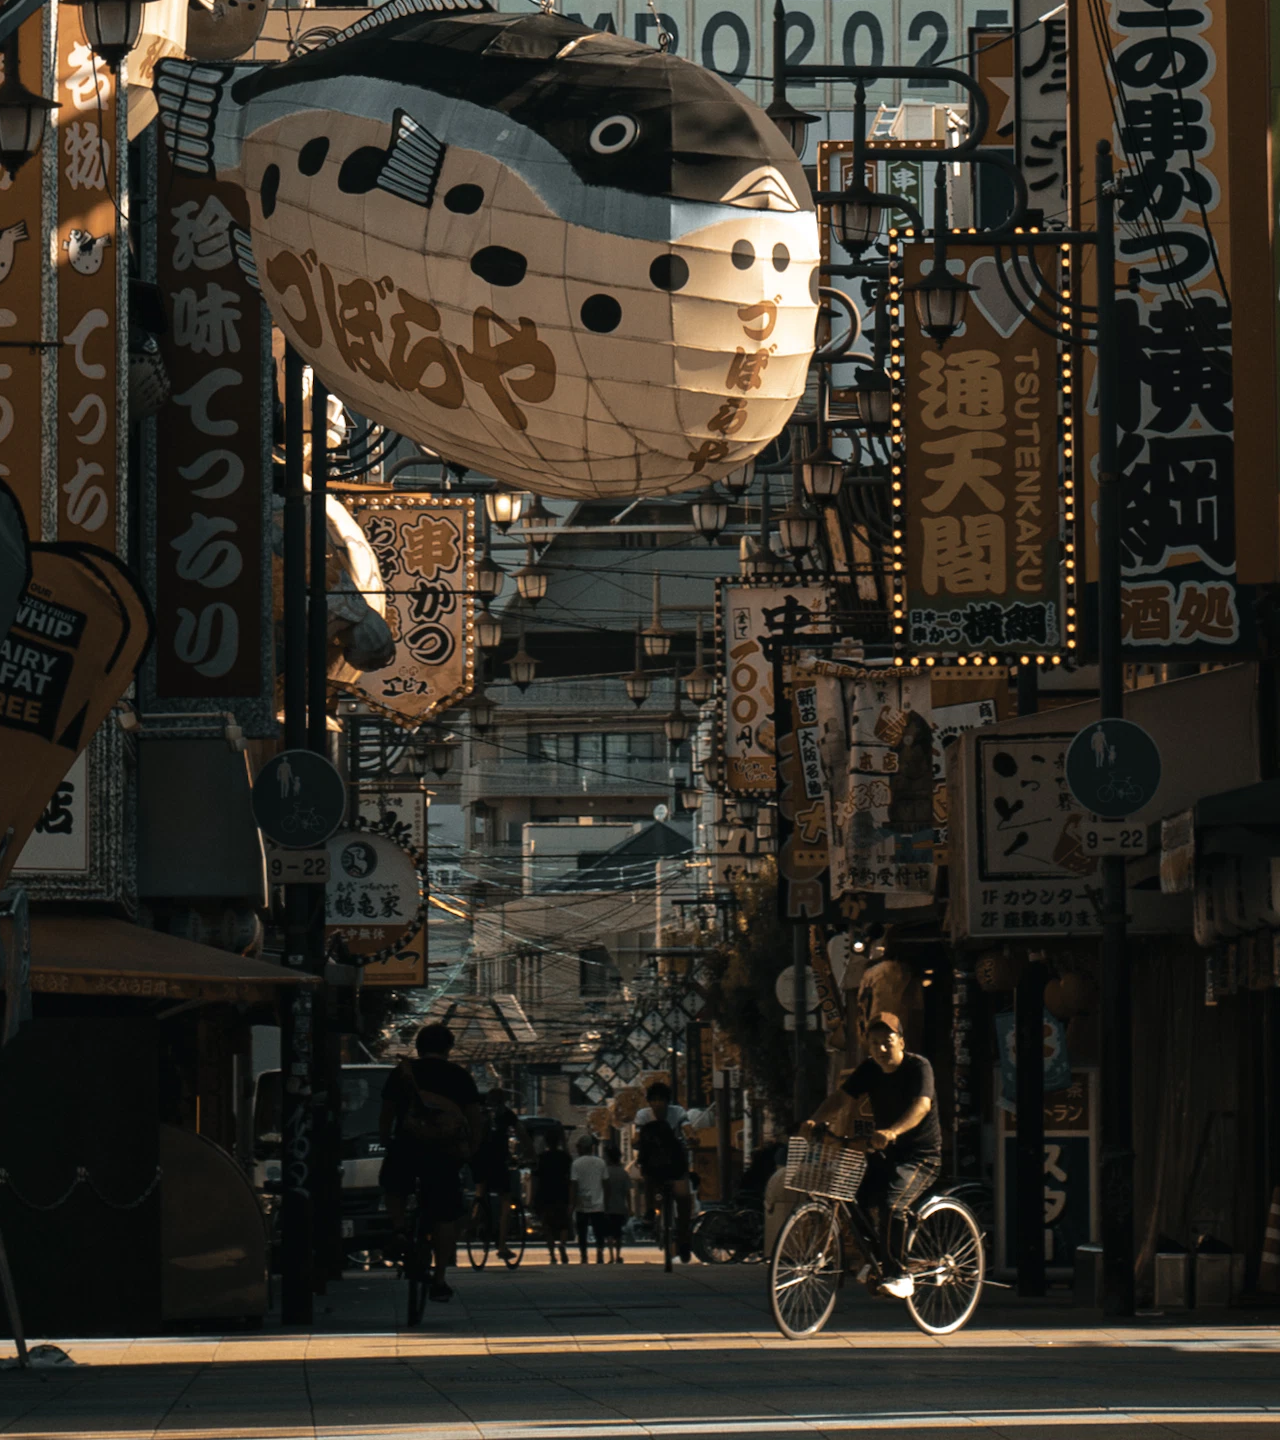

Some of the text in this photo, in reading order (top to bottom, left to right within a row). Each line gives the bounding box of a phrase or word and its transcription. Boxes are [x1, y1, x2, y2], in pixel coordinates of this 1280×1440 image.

[266, 248, 558, 432] づぼらや
[919, 349, 1007, 595] 通天閣
[1013, 347, 1044, 592] TSUTENKAKU
[402, 516, 458, 663] 串かつ
[911, 610, 962, 626] 日本一の
[962, 601, 1048, 645] 横綱
[1086, 830, 1144, 849] 9-22
[271, 857, 327, 877] 9-22
[335, 892, 404, 919] 鶴亀家
[1003, 888, 1102, 907] カウンター
